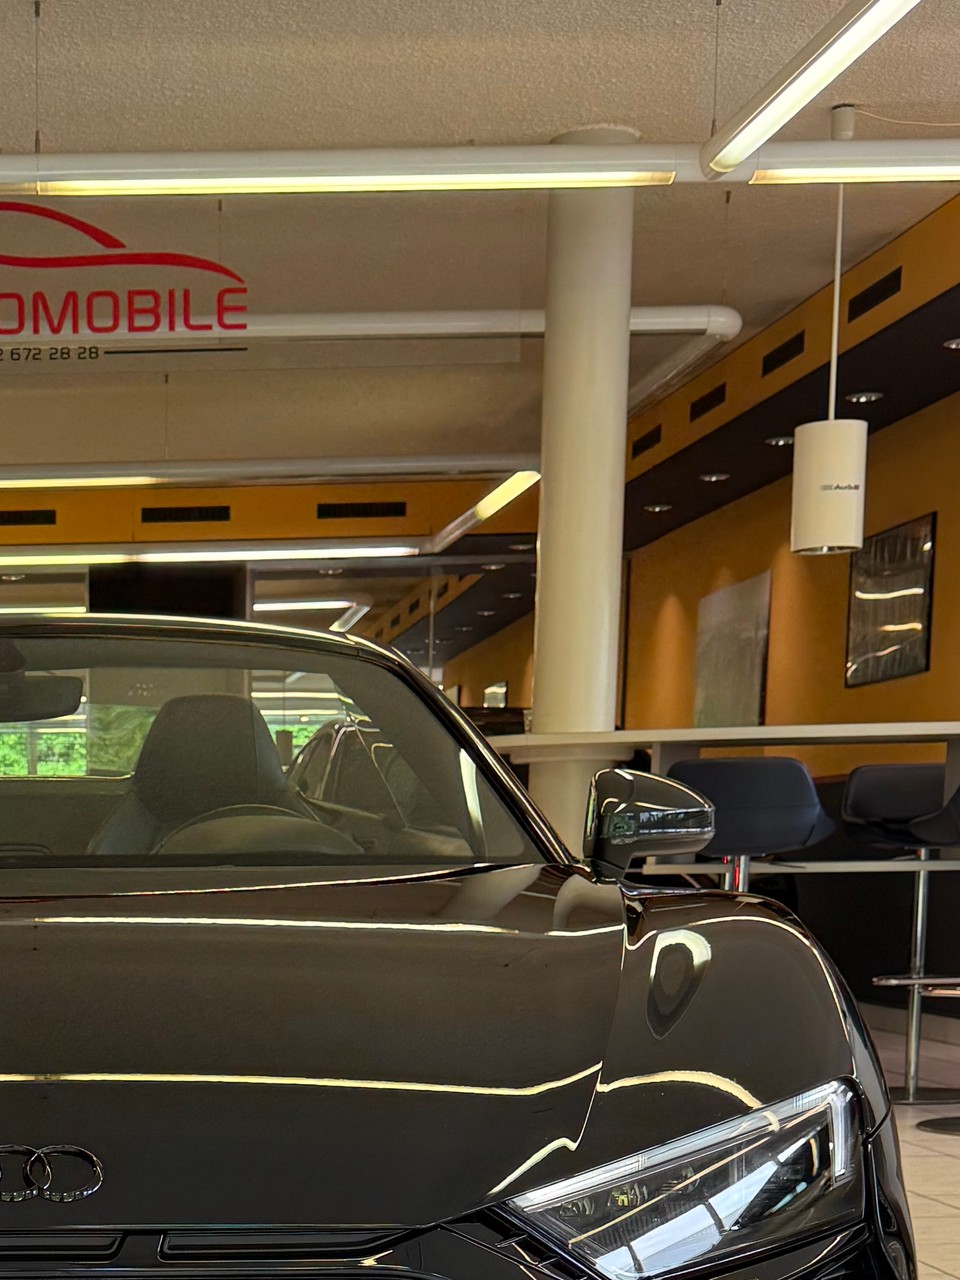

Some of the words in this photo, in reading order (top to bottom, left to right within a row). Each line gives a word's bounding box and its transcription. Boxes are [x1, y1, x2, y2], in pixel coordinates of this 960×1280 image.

[10, 347, 42, 361] 672
[48, 347, 71, 361] 28
[77, 346, 100, 360] 28
